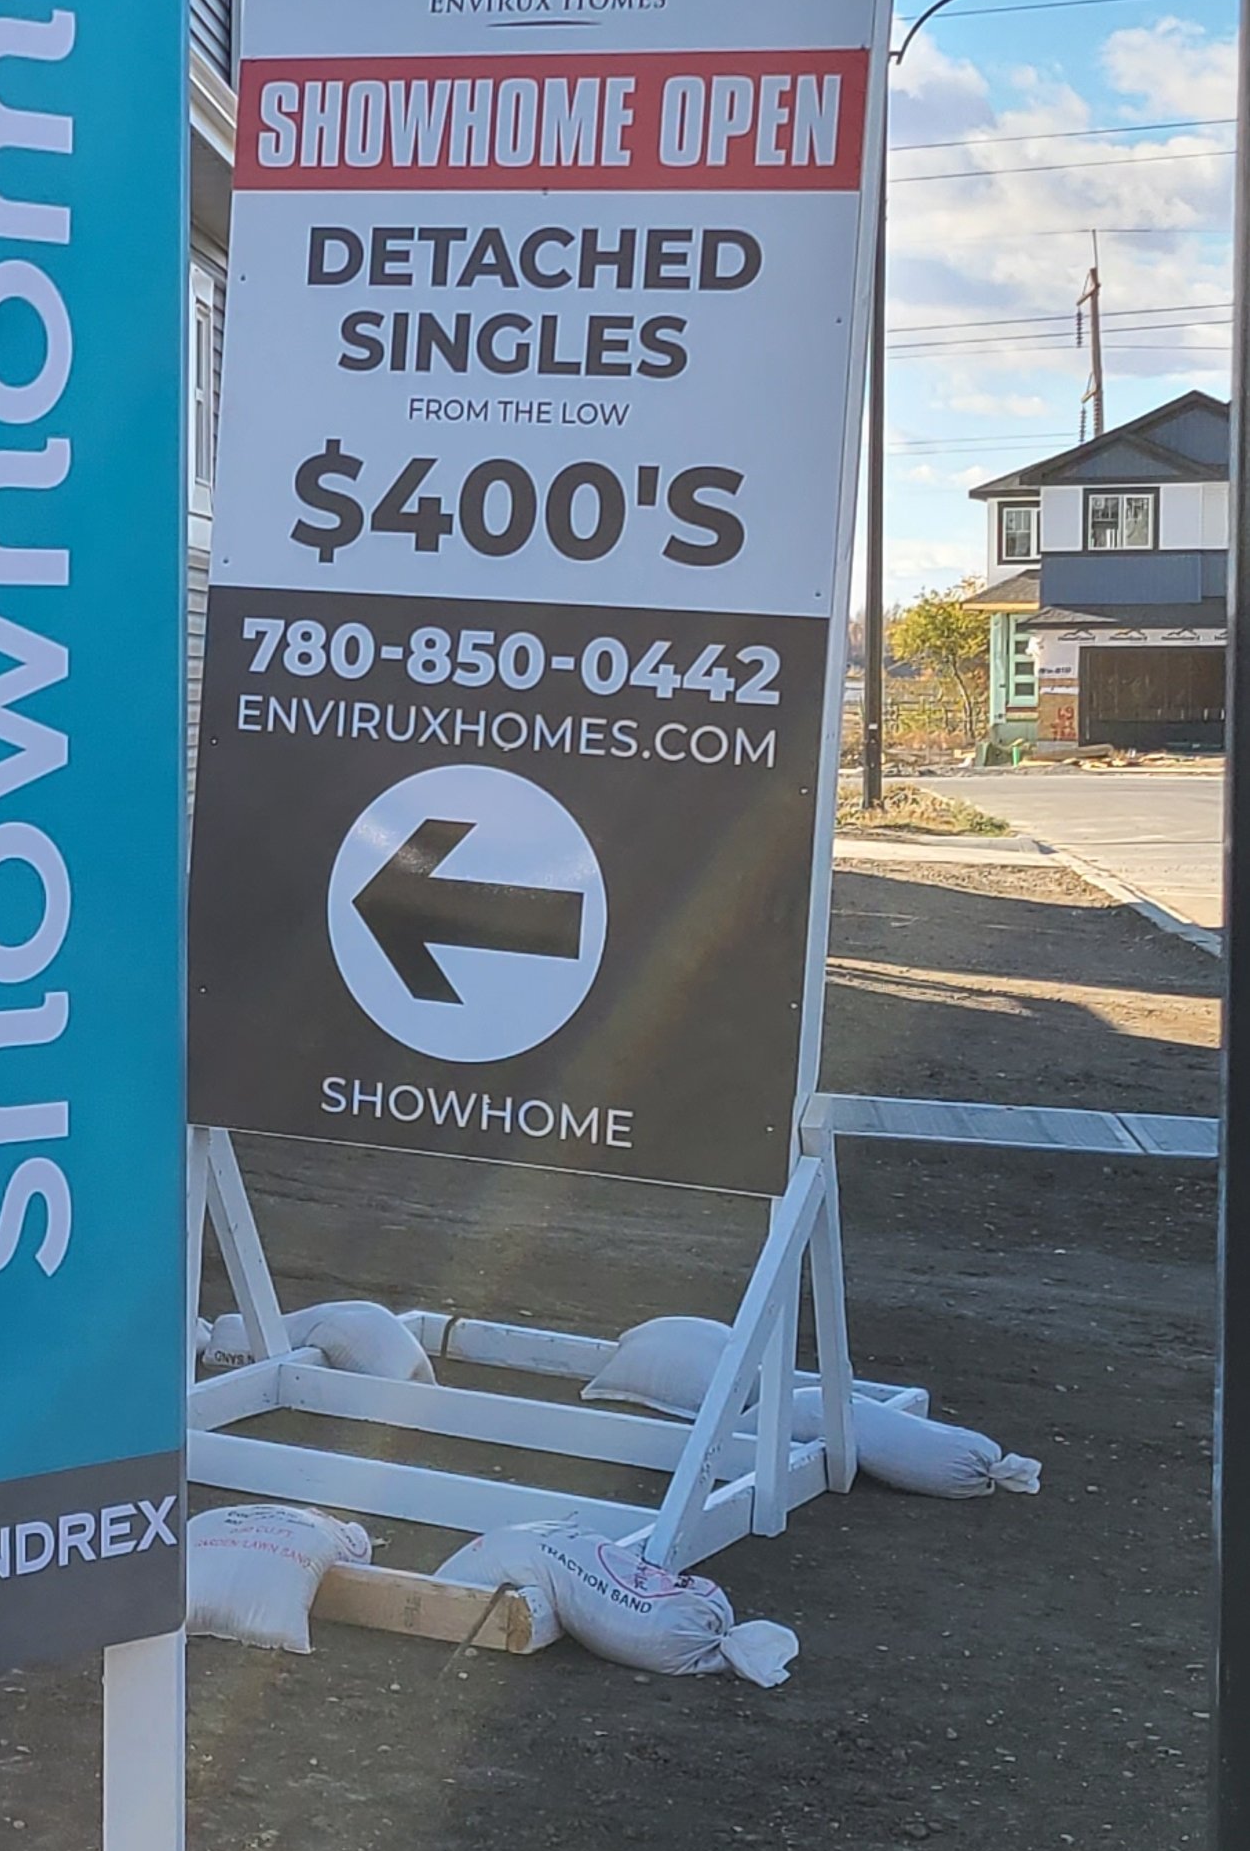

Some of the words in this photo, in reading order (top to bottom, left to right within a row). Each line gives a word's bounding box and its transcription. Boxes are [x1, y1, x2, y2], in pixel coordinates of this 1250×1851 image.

[257, 75, 635, 168] SHOWHOME
[658, 73, 842, 166] OPEN
[307, 227, 762, 291] DETACHED
[337, 311, 689, 379] SINGLES
[408, 398, 489, 422] FROM
[498, 400, 552, 424] THE
[561, 402, 630, 426] LOW
[290, 439, 745, 566] $400'S
[242, 618, 782, 706] 780-850-0442
[237, 694, 778, 768] ENVIRUXHOMES.COM
[320, 1077, 633, 1148] SHOWHOME
[540, 1543, 609, 1596] TRACTION
[611, 1589, 652, 1615] SAND
